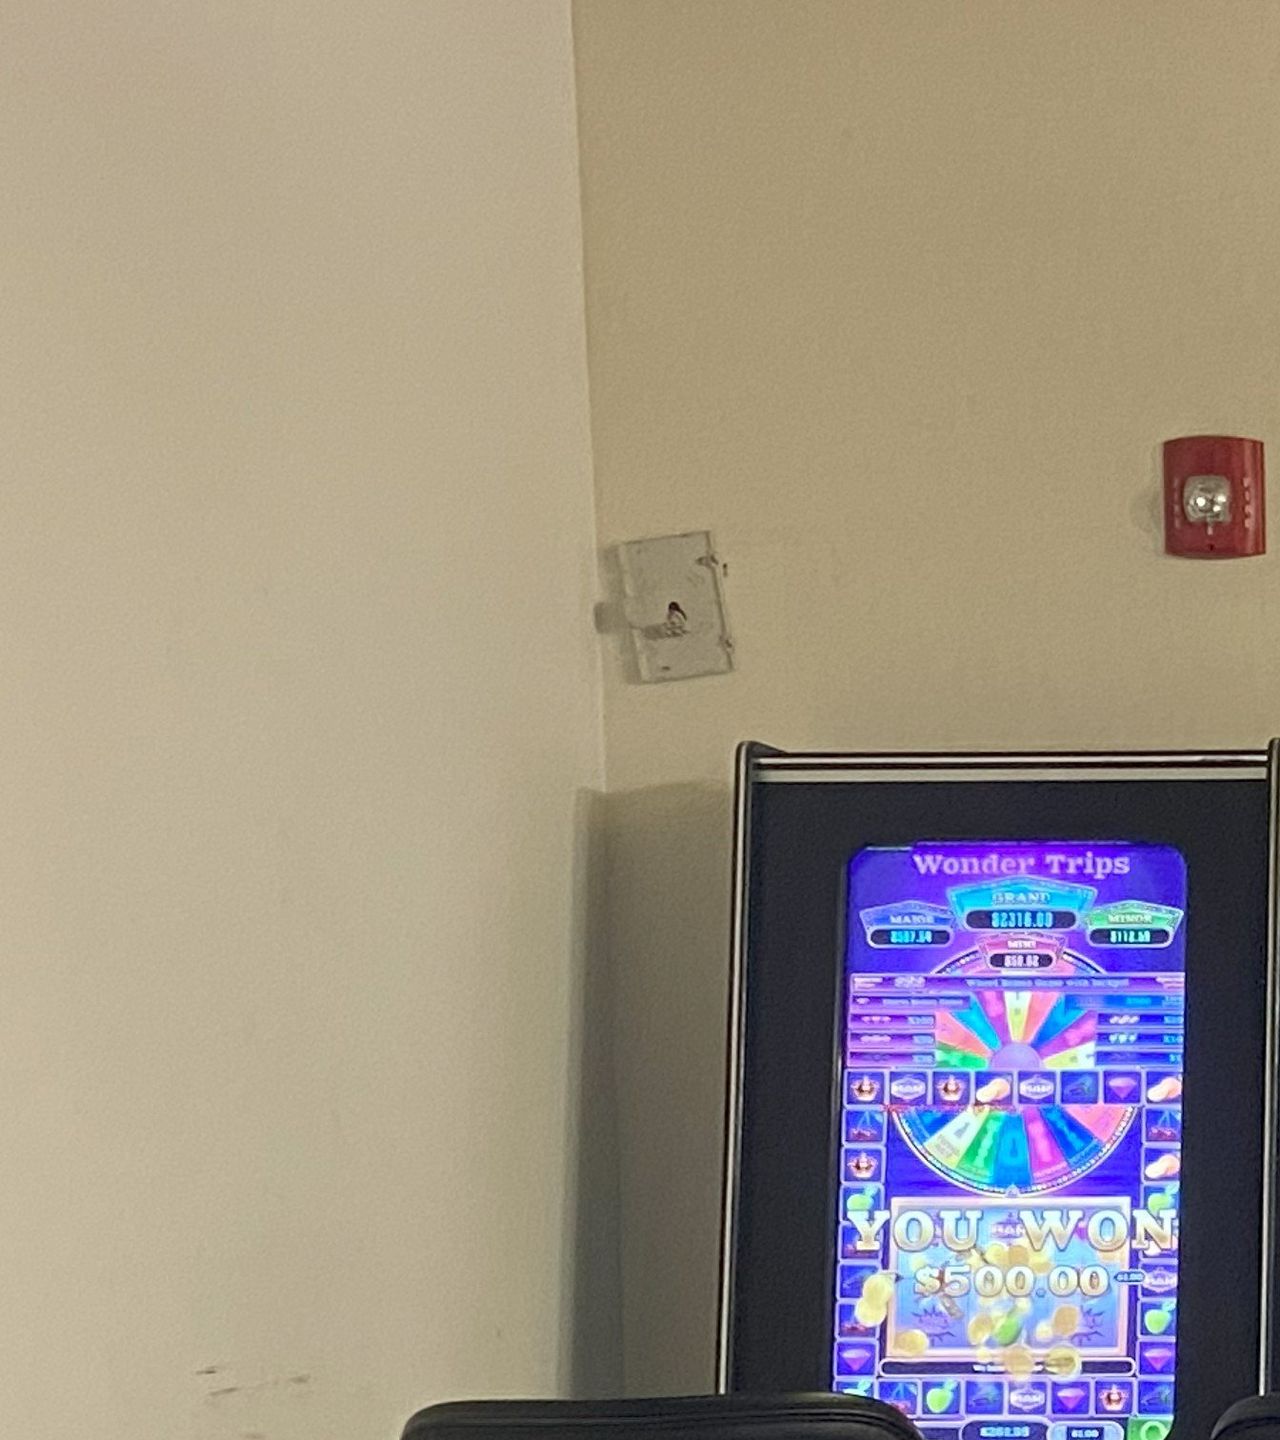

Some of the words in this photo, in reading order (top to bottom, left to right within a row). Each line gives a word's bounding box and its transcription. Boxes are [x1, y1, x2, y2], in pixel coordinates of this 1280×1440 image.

[912, 853, 1035, 875] Wonder
[1045, 851, 1131, 879] Trips
[846, 1209, 984, 1252] YOU
[1018, 1208, 1178, 1252] WON
[913, 1264, 1110, 1299] $500.00
